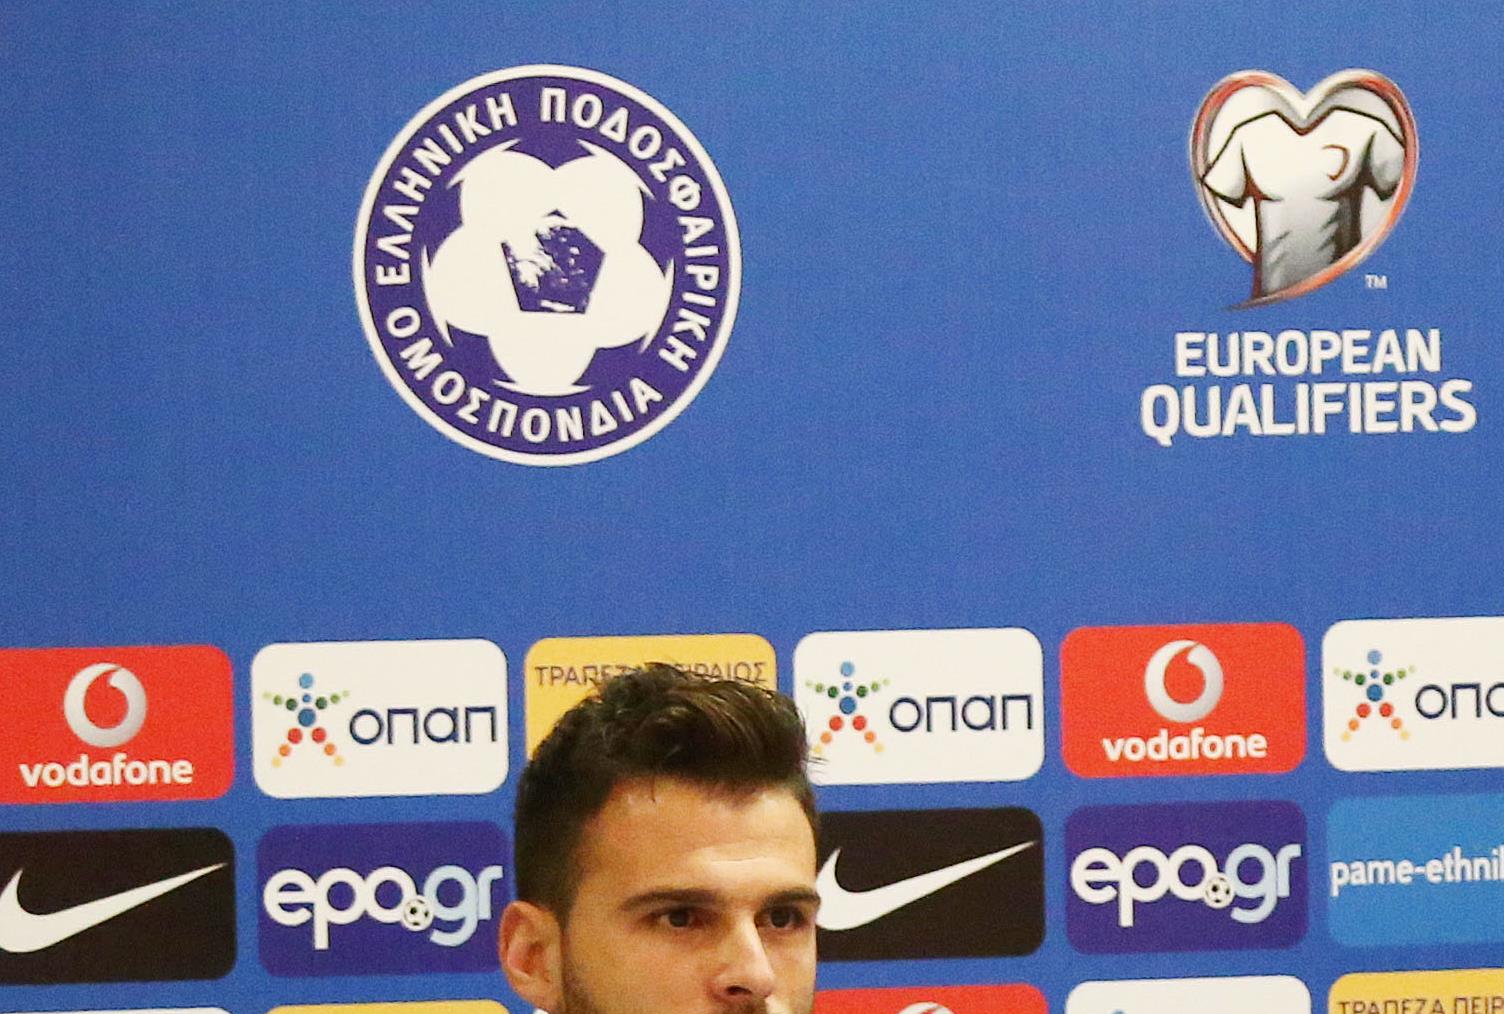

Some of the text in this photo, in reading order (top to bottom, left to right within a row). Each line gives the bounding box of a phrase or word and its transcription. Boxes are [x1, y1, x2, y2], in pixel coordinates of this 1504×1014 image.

[376, 87, 720, 443] ΕΛΛΗΝΙΚΗ ΠΟΔΟΣΦΑΙΡΙΚΗ ΟΜΟΣΠΟΝΔΙΑ
[1175, 328, 1442, 377] EUROPEAN
[1140, 379, 1477, 447] QUALIFIERS
[18, 753, 194, 787] vodafone
[1101, 728, 1268, 763] vodafone
